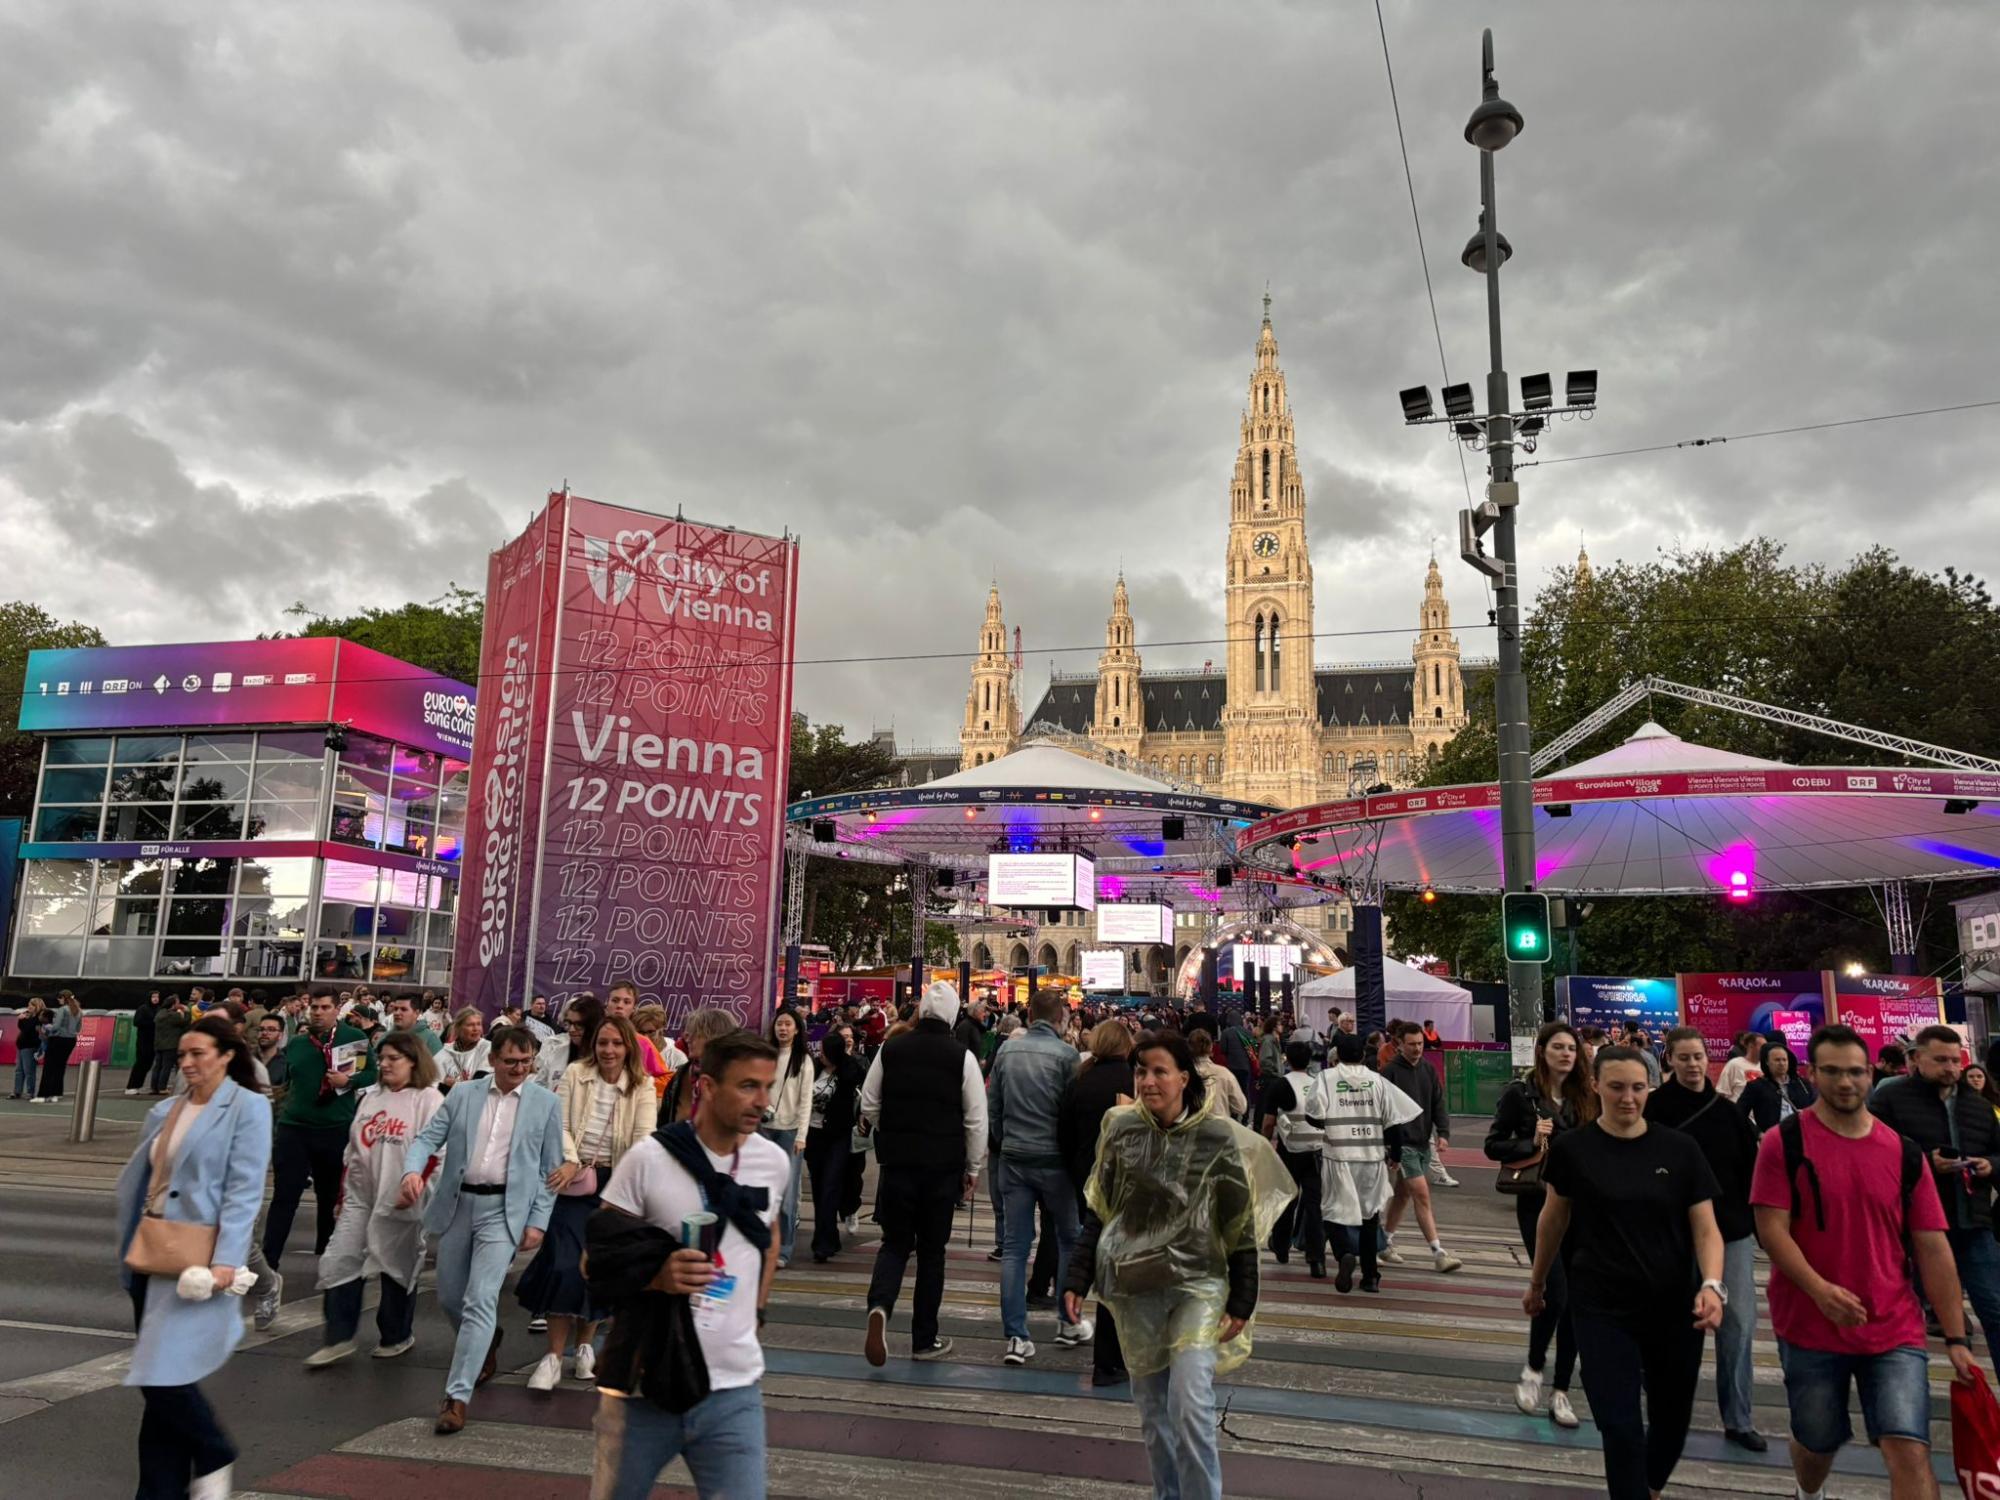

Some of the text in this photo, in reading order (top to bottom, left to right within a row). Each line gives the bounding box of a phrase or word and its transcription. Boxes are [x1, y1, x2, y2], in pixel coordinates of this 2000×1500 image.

[657, 551, 771, 597] City of
[657, 584, 773, 632] Vienna
[577, 630, 772, 689] 12 POINTS
[103, 681, 142, 691] ORF ON
[575, 671, 769, 726] 12 POINTS
[571, 711, 764, 780] Vienna
[1575, 778, 1662, 791] Eurovision Village
[1849, 778, 1875, 787] ORF
[1907, 776, 1921, 785] City
[1635, 785, 1660, 793] 2026
[566, 776, 763, 826] 12 POINTS
[562, 819, 761, 868] 12 POINTS
[558, 862, 759, 909] 12 POINTS
[555, 905, 756, 949] 12 POINTS
[551, 947, 754, 990] 12 POINTS
[1592, 983, 1625, 991] Welcome
[1598, 990, 1648, 1003] VIENNA
[1702, 998, 1727, 1007] City of
[1703, 1006, 1728, 1014] Vienna
[1853, 1016, 1874, 1026] City of
[1880, 1012, 1938, 1025] Vienna Vienna
[1854, 1025, 1876, 1034] Vienna
[1339, 1098, 1374, 1107] Steward
